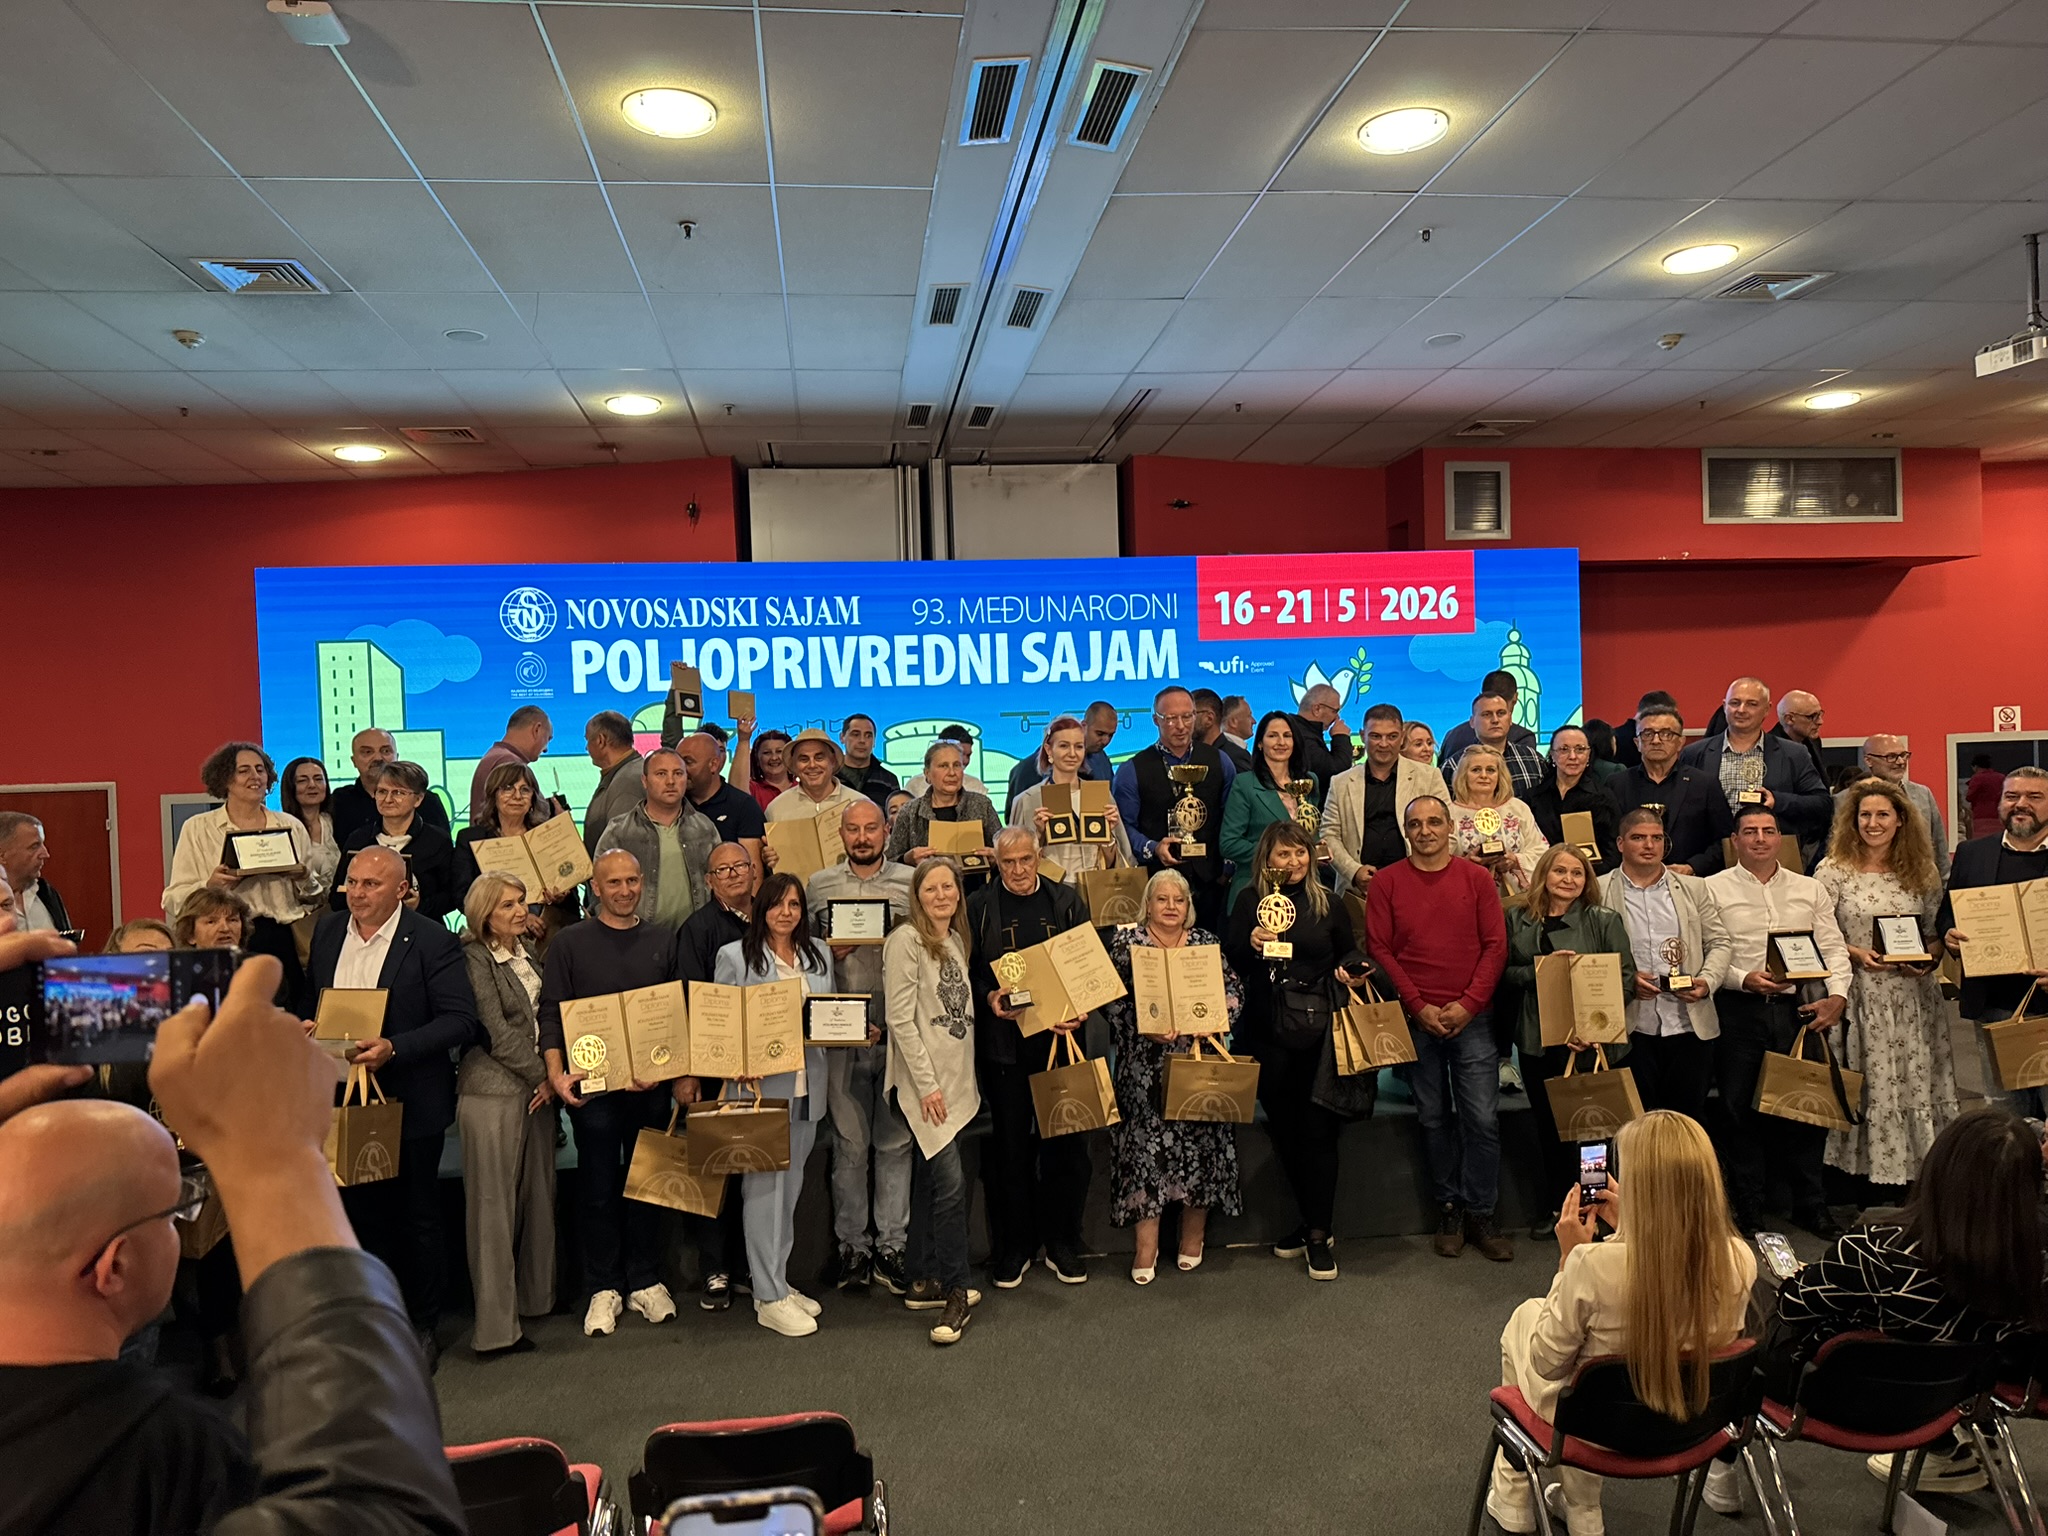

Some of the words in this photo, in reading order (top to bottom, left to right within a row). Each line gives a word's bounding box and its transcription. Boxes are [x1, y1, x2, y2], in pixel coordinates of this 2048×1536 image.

[564, 597, 760, 630] NOVOSADSKI
[765, 596, 862, 627] SAJAM
[912, 598, 952, 626] 93.
[959, 593, 1178, 624] MEĐUNARODNI
[1380, 585, 1460, 622] 2026
[1021, 628, 1180, 684] SAJAM
